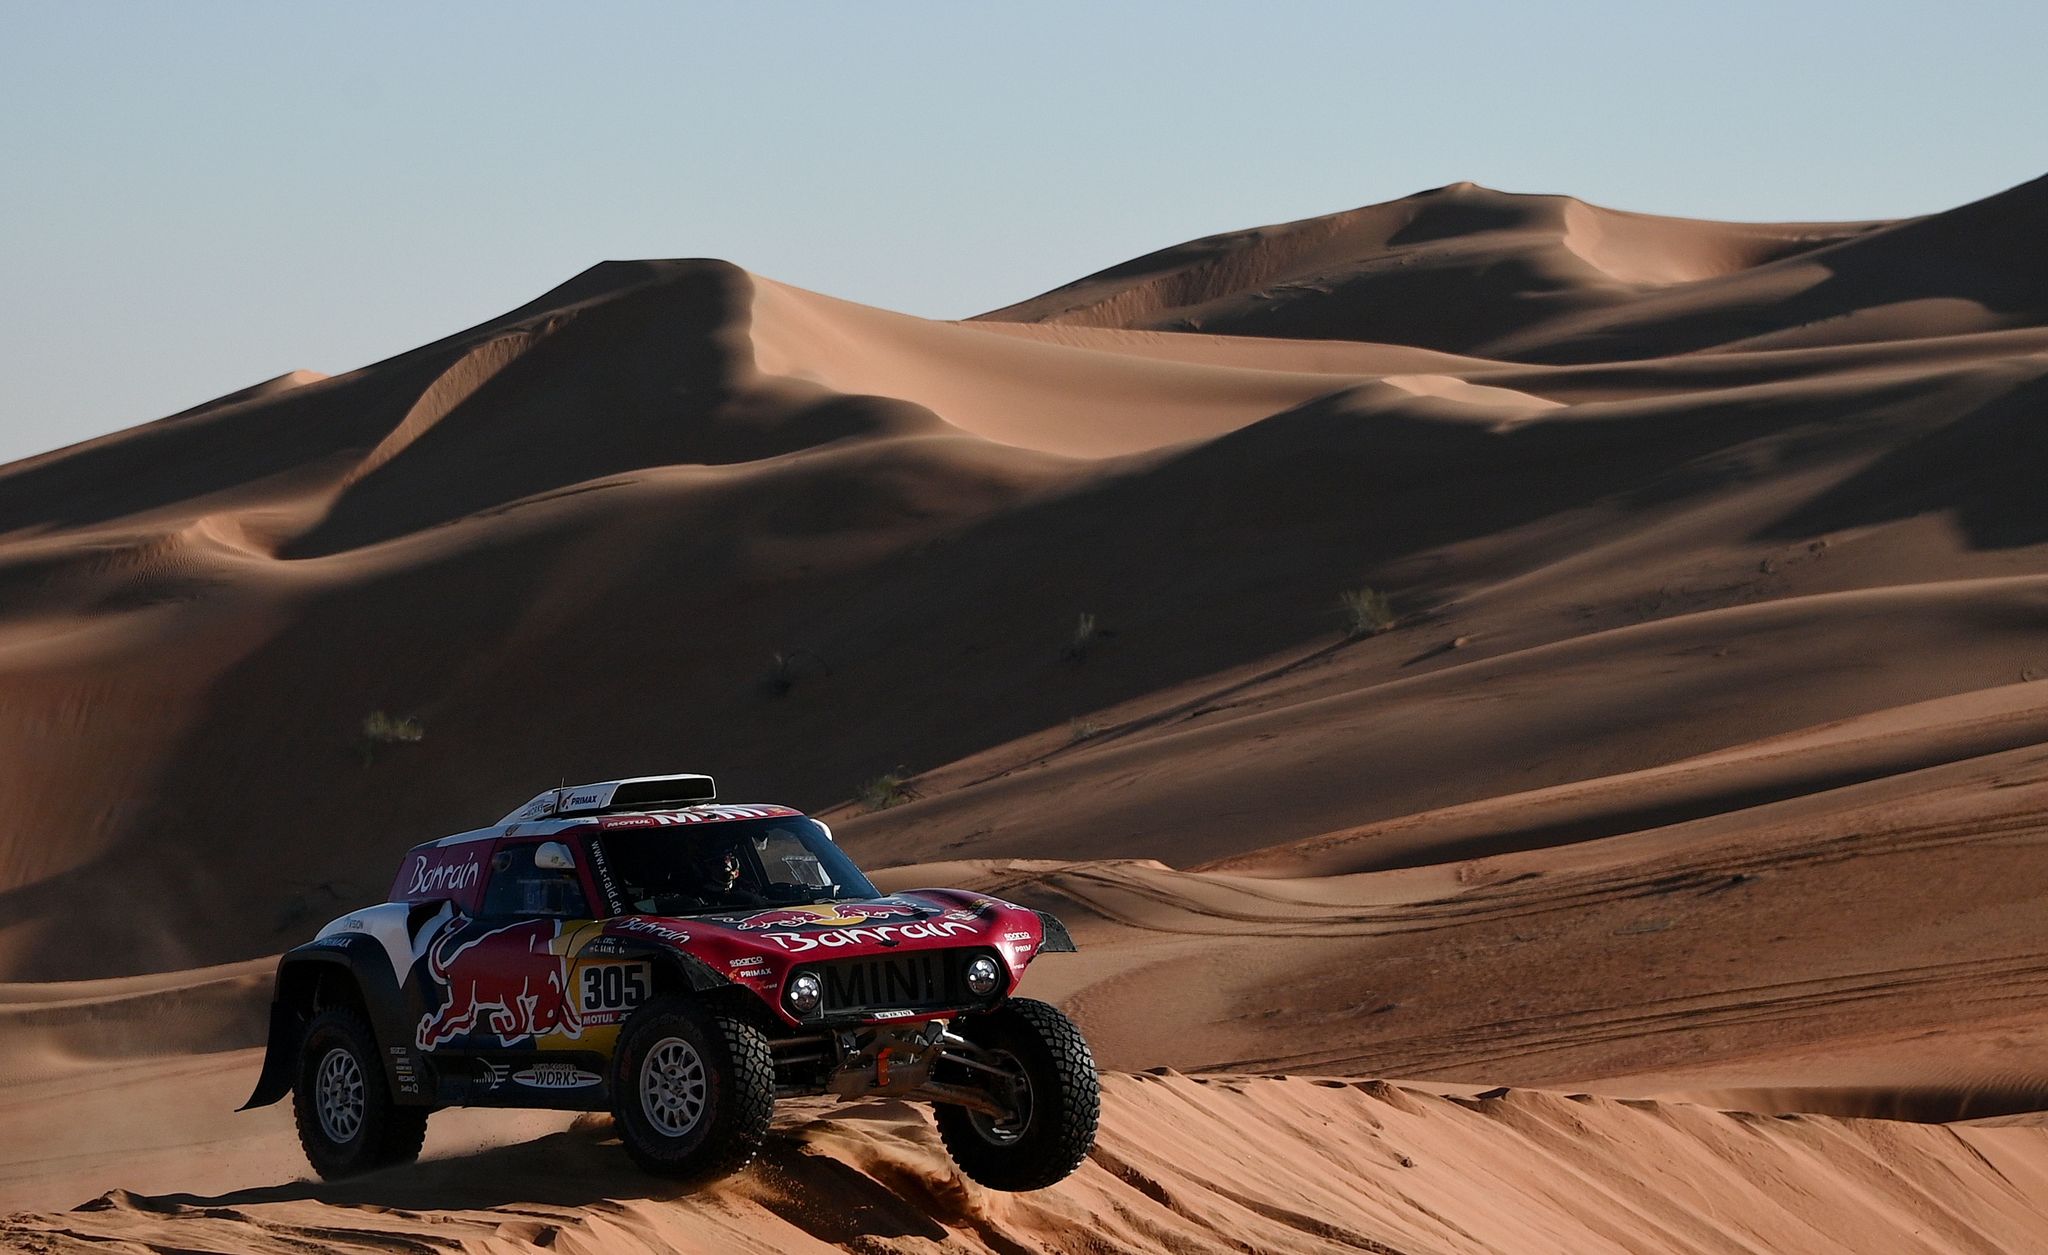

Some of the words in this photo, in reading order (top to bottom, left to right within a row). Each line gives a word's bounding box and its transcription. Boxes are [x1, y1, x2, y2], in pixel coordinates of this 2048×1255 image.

[571, 795, 598, 805] PRIMAX
[606, 819, 652, 829] MOTUL
[407, 851, 480, 895] Bahrain
[591, 840, 622, 915] www.x-raid.de
[616, 917, 691, 944] Bahrain
[760, 918, 979, 952] Bahrain
[729, 956, 764, 967] sparco
[740, 967, 772, 978] PRIMAX
[584, 965, 645, 1010] 305
[826, 958, 934, 1008] MINI
[583, 1013, 614, 1025] MOTUL
[535, 1071, 578, 1085] WORKS
